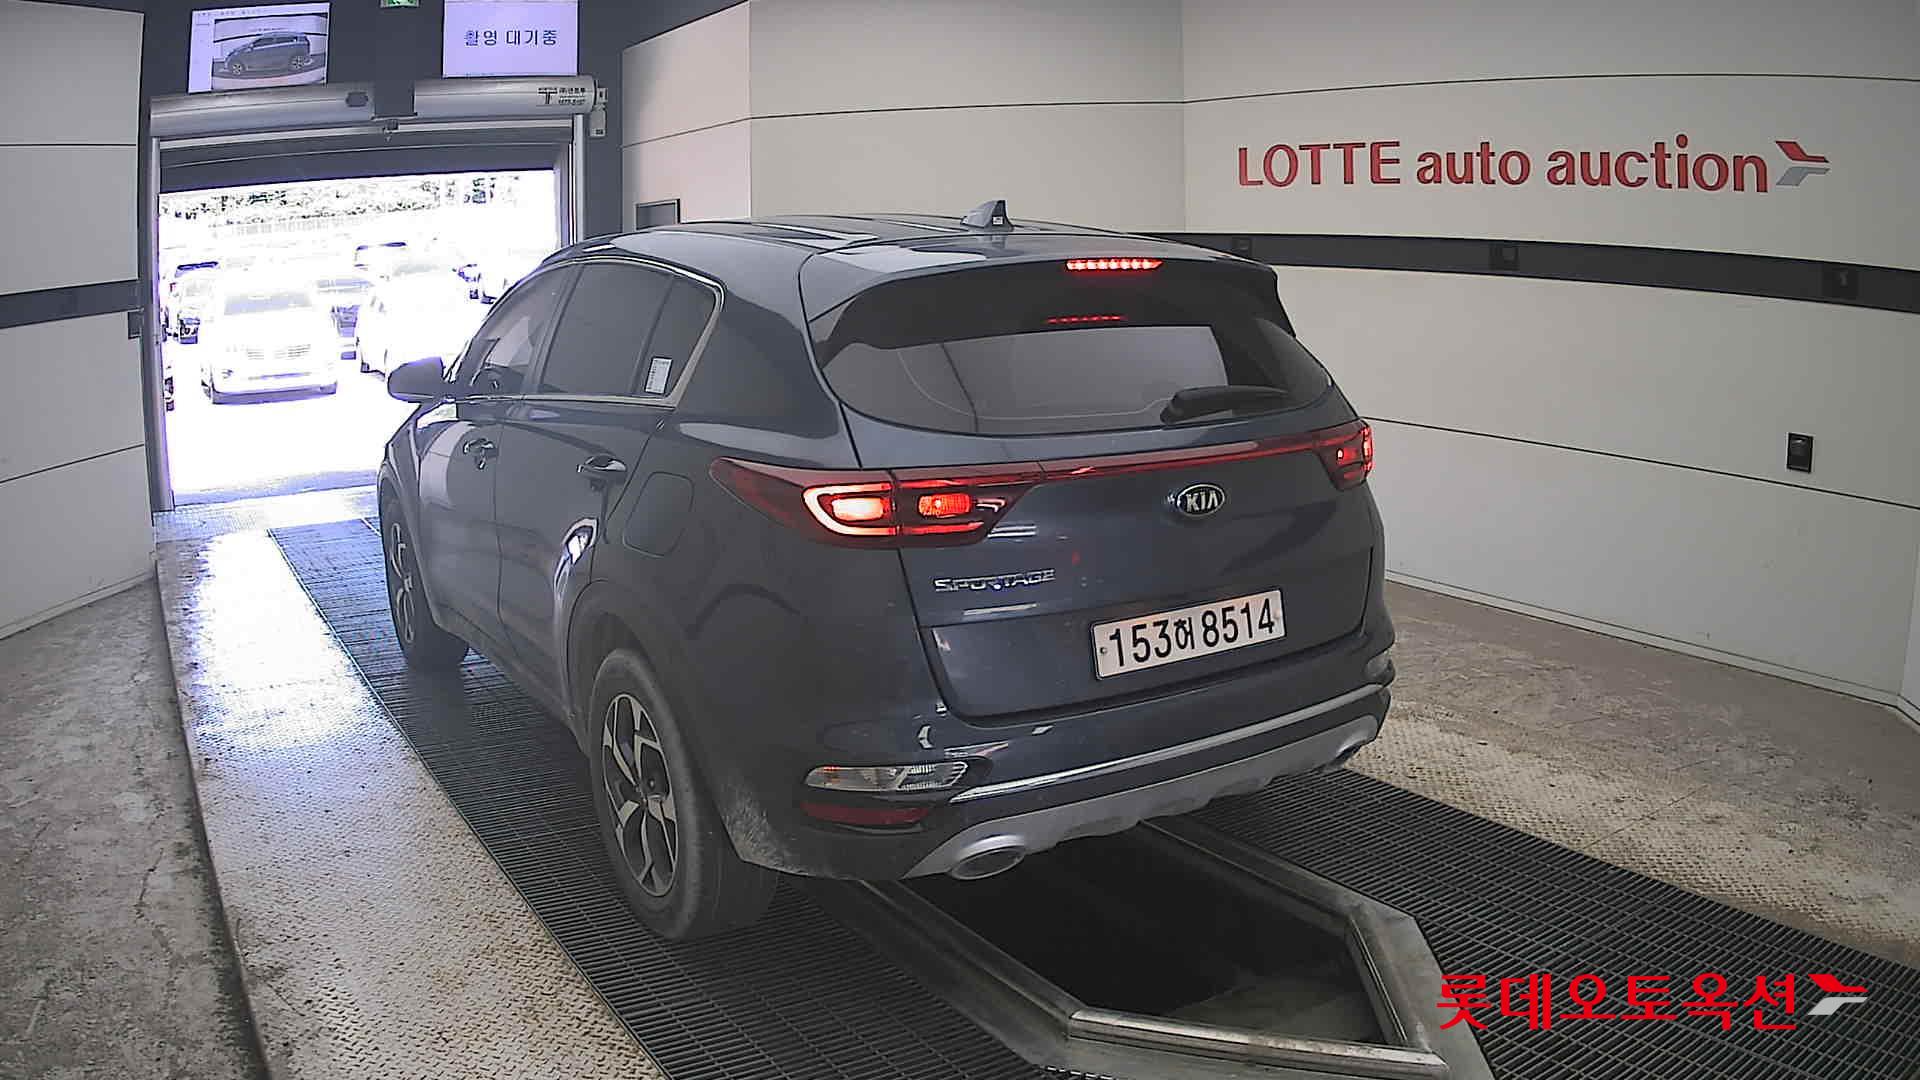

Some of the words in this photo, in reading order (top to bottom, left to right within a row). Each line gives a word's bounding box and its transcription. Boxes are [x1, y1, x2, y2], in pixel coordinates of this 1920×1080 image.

[1238, 140, 1401, 188] LOTTE
[1416, 141, 1532, 186] auto
[1546, 134, 1770, 193] auction
[1185, 490, 1219, 512] KIA
